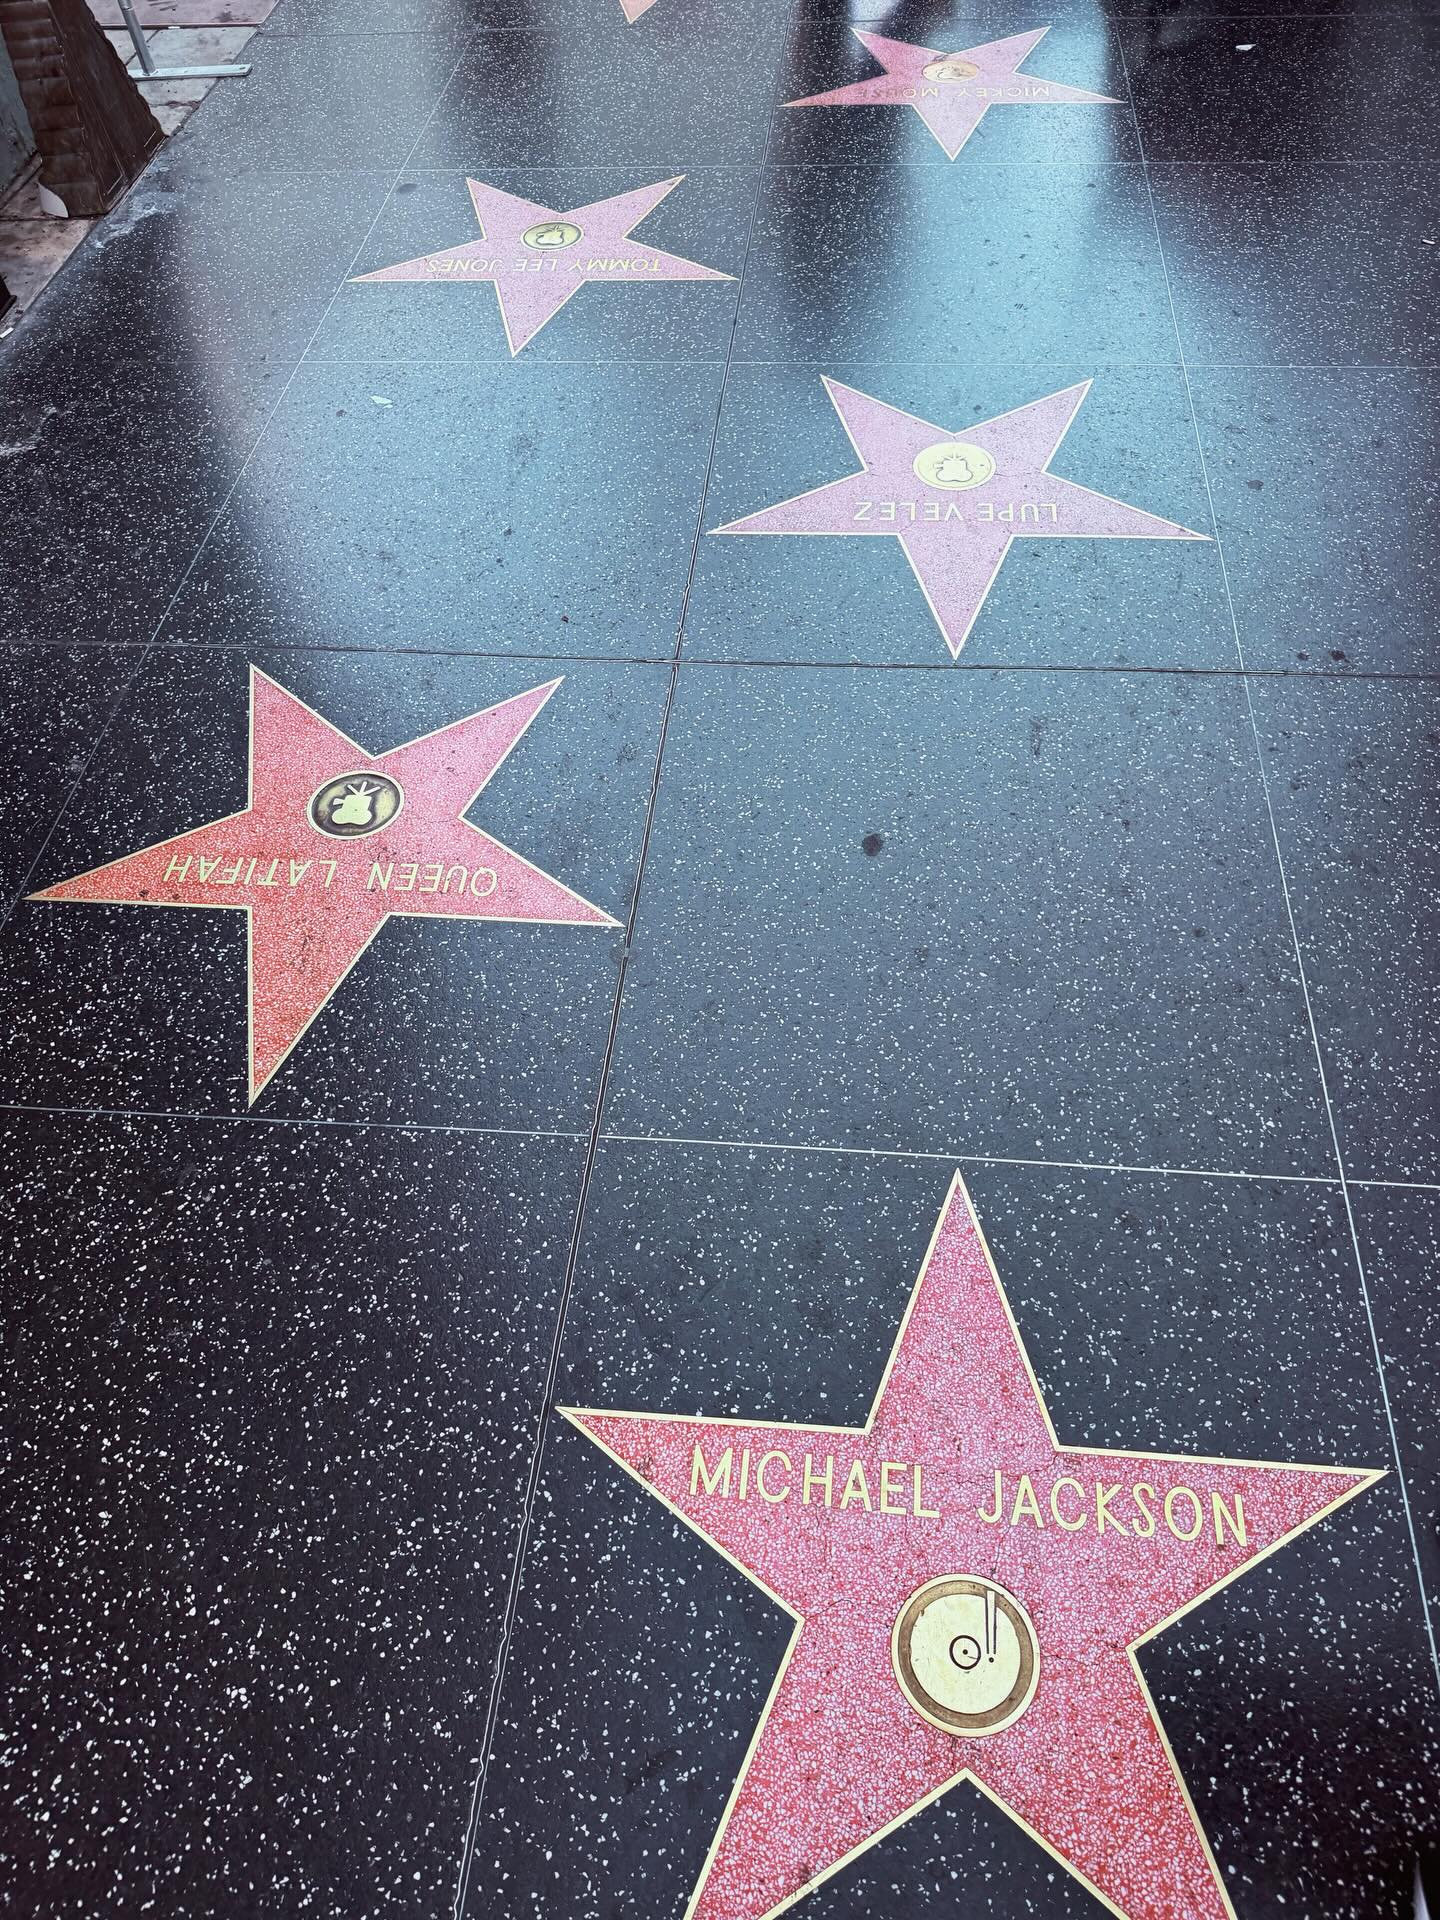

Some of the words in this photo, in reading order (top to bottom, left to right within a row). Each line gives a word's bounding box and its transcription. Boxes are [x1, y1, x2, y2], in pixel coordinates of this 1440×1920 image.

[958, 87, 1050, 97] MICKEY
[426, 258, 501, 273] JONES
[514, 258, 558, 273] LEE
[573, 258, 661, 273] TOMMY
[853, 501, 964, 521] VELEZ
[976, 502, 1058, 523] LUPE
[163, 855, 337, 888] LATIFAH
[366, 862, 498, 897] QUEEN
[689, 1445, 941, 1520] MICHAEL
[977, 1469, 1248, 1549] JACKSON
